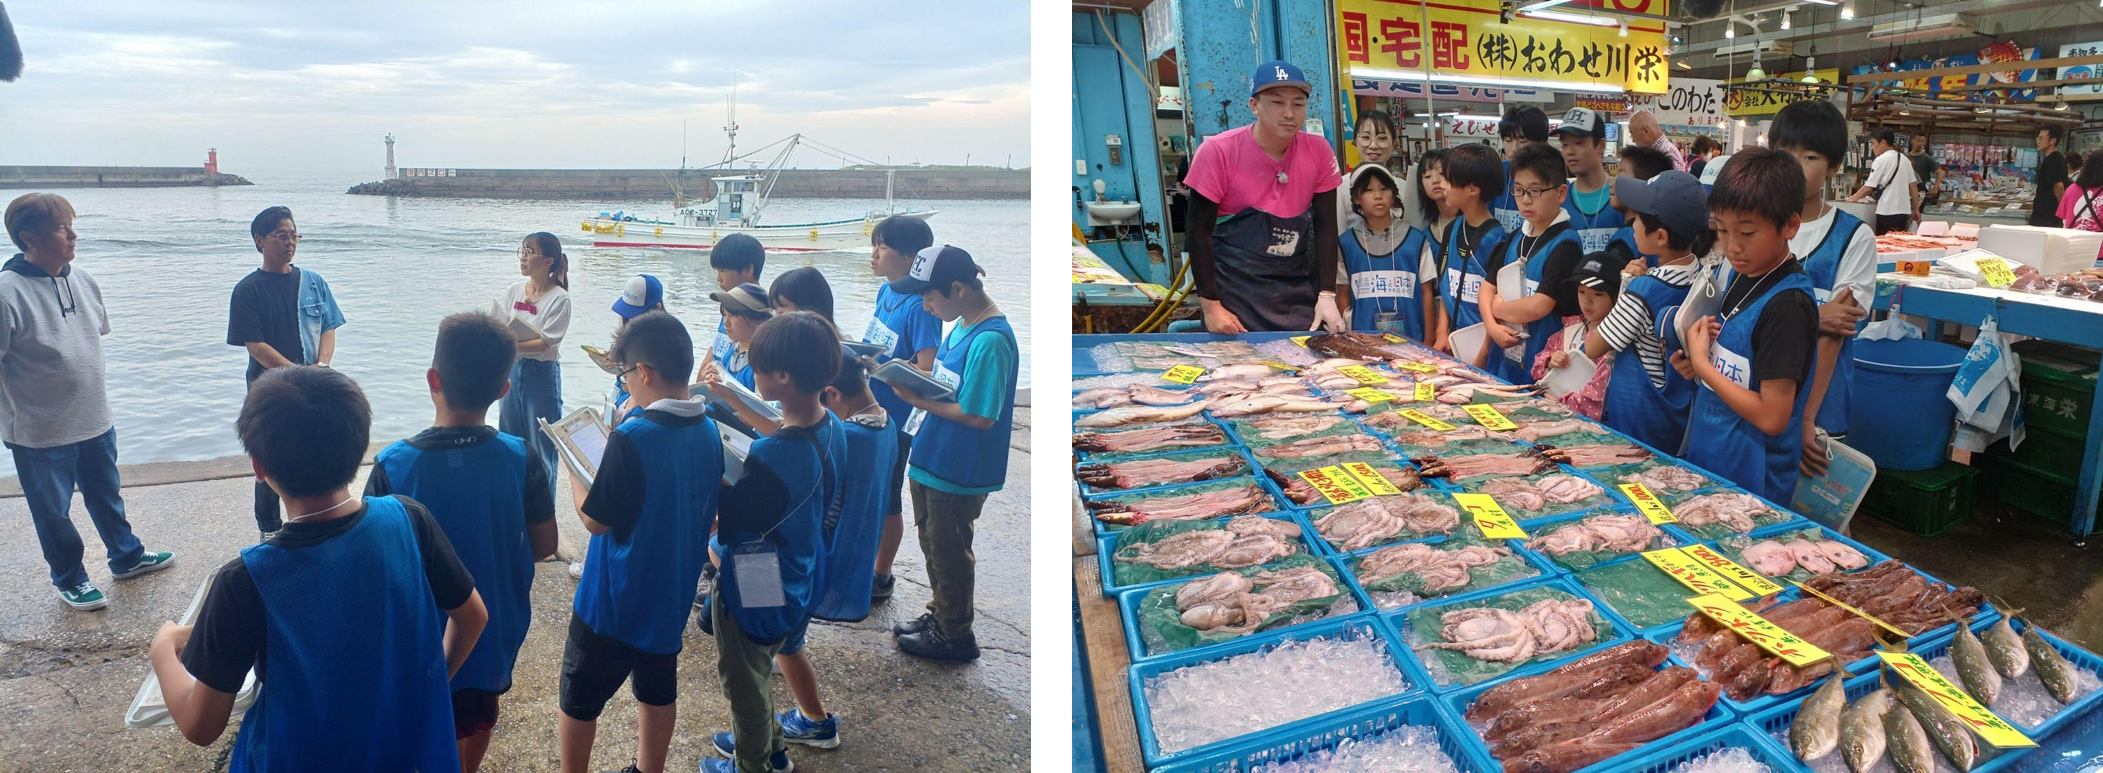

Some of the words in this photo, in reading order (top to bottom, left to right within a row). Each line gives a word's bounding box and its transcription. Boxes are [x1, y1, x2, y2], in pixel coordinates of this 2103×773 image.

[1275, 65, 1289, 80] LA
[1452, 119, 1501, 135] えびせ
